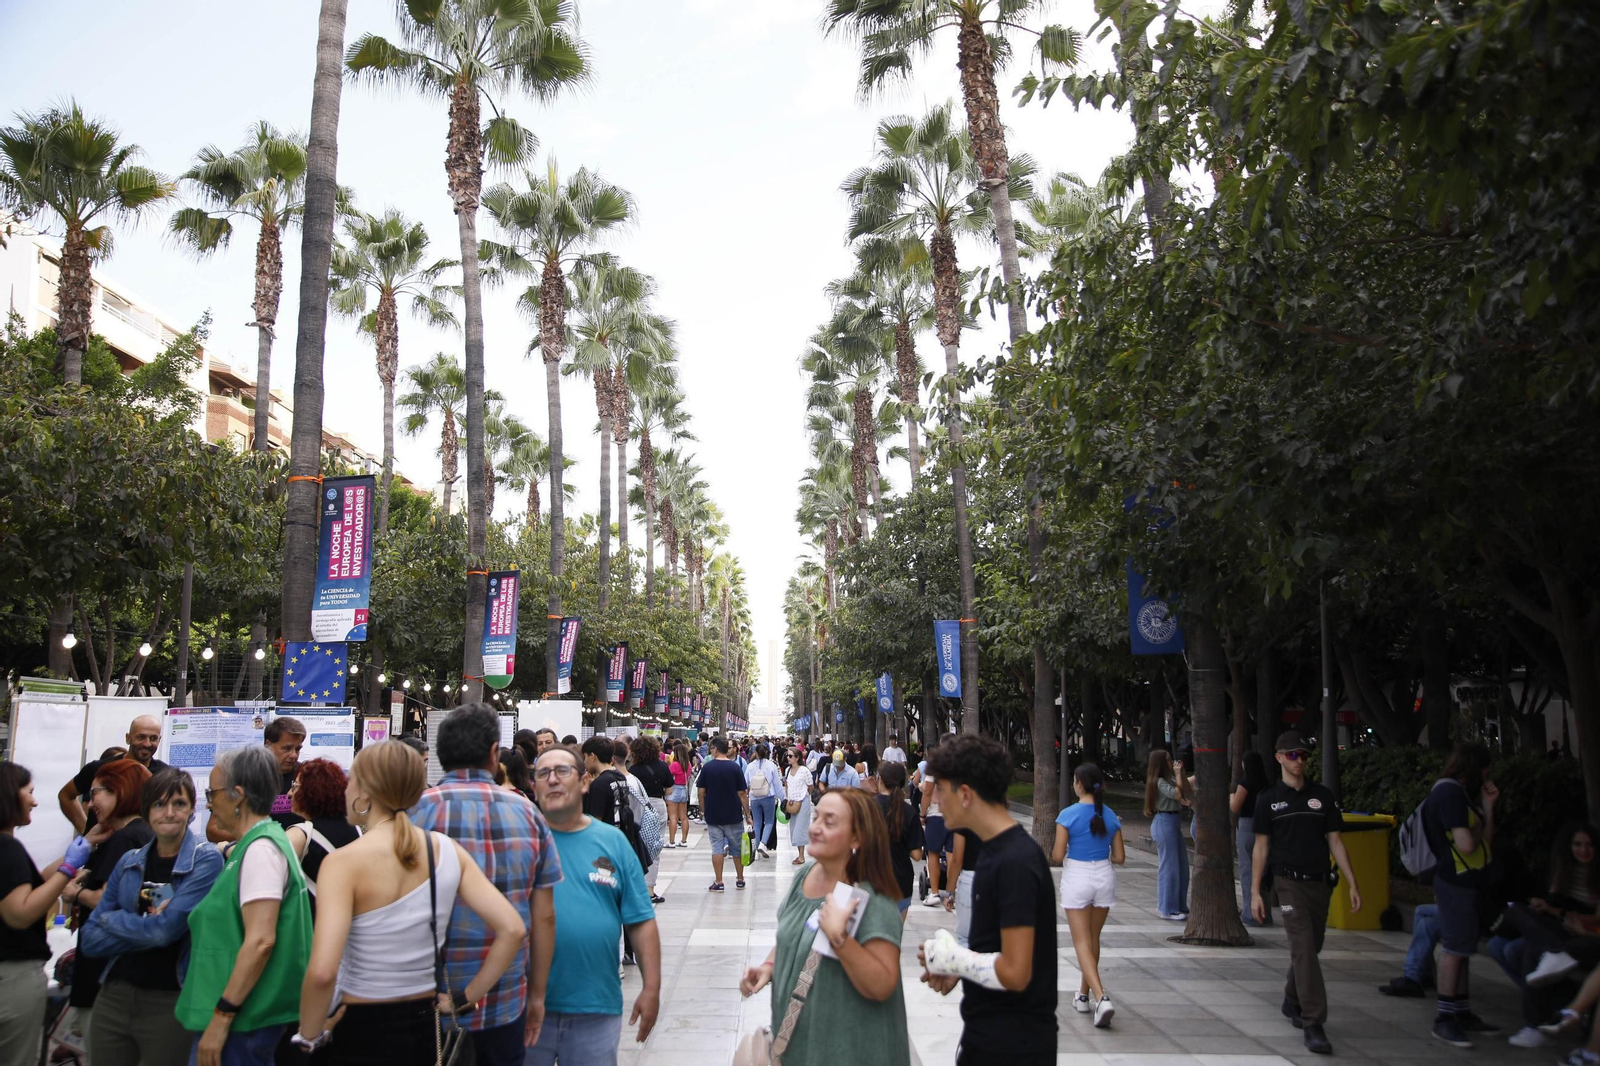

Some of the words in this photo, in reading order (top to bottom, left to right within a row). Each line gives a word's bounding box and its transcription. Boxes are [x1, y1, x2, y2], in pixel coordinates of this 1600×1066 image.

[345, 512, 352, 525] DE
[353, 488, 364, 576] INVESTIGADOR@S
[332, 524, 341, 558] NOCHE
[341, 530, 352, 576] EUROPEA
[330, 564, 339, 577] LA
[501, 594, 506, 602] DE
[491, 626, 497, 635] LA
